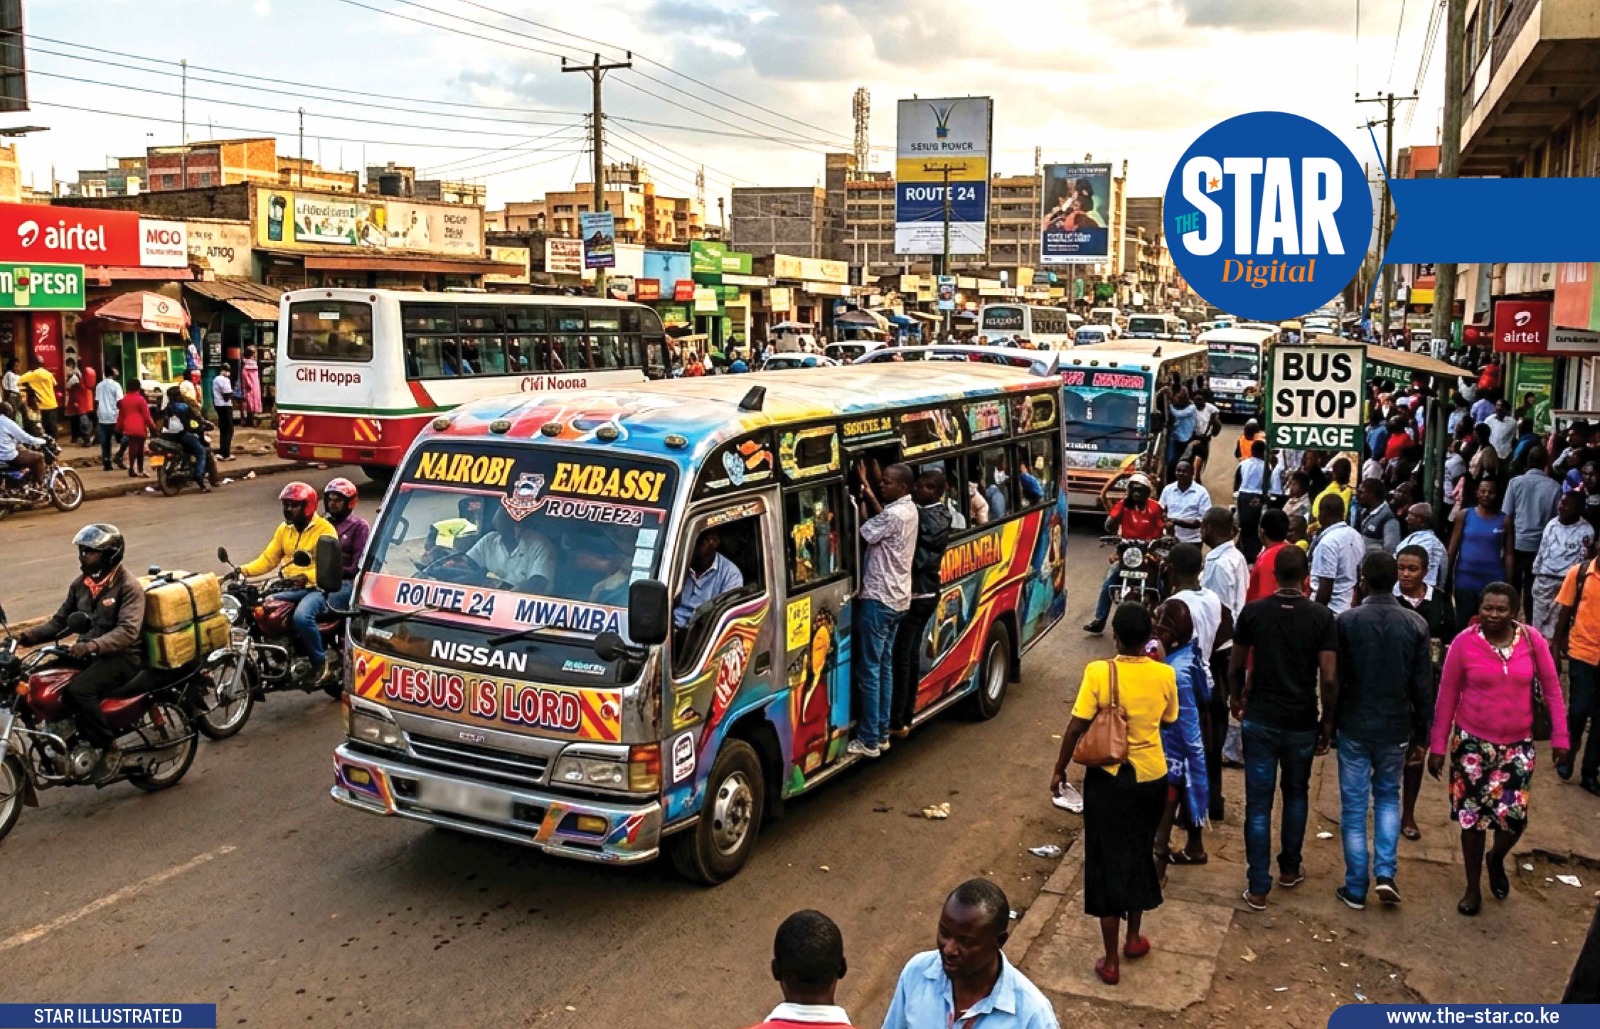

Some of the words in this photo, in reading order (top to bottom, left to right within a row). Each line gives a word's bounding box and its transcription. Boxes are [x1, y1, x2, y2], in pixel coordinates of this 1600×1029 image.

[906, 187, 953, 201] ROUTE
[957, 187, 975, 201] 24
[44, 220, 107, 251] airtel
[31, 272, 78, 294] PESA
[1503, 331, 1540, 343] airtel
[320, 369, 361, 385] Hoppa
[1282, 352, 1352, 383] BUS
[1276, 389, 1357, 418] STOP
[1276, 426, 1355, 447] STAGE
[413, 451, 514, 487] NAIROBI
[549, 462, 667, 502] EMBASSI
[395, 581, 465, 612] ROUTE
[468, 593, 496, 616] 24
[514, 598, 620, 634] MWAMBA
[431, 640, 528, 672] NISSAN
[385, 664, 465, 710] JESUS
[469, 677, 496, 717] IS
[502, 683, 581, 729] LORD
